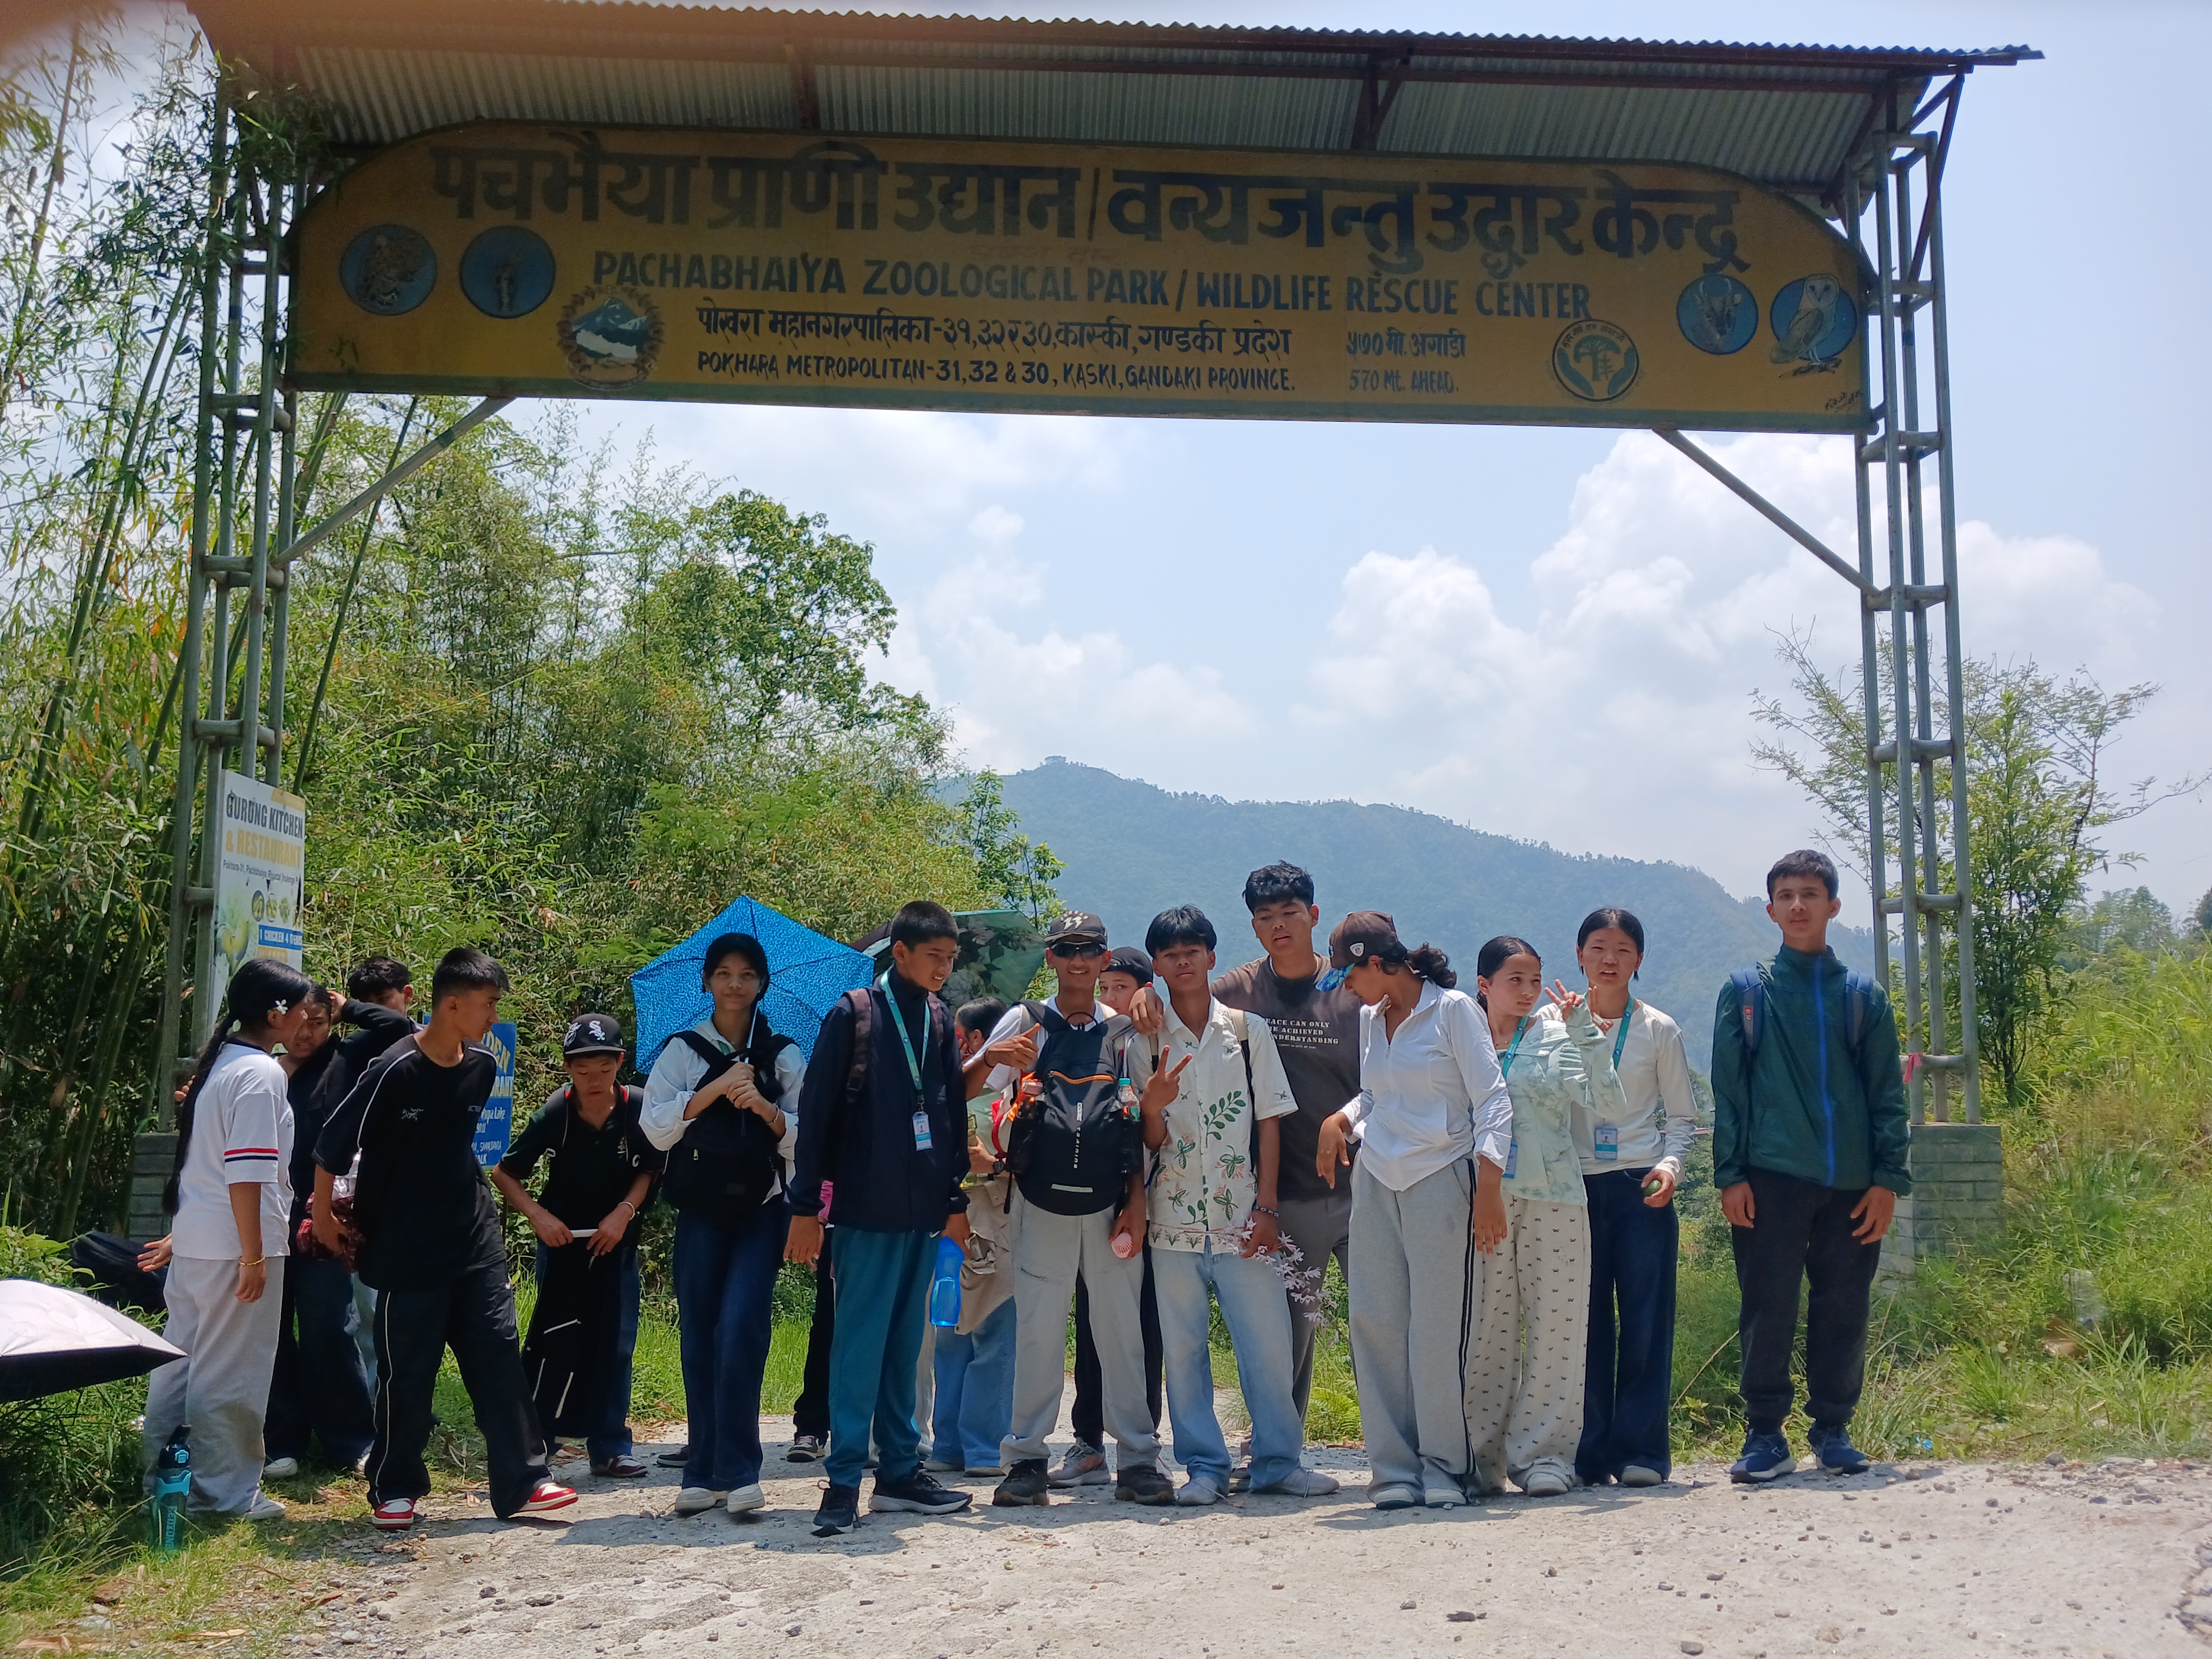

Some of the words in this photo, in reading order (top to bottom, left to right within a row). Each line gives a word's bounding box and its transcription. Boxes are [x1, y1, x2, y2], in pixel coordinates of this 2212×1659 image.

[594, 250, 847, 294] PACHABHAIYA
[863, 259, 1078, 301] ZOOLOGICAL
[1197, 272, 1331, 311] WILDLIFE
[1347, 276, 1458, 314] RESCUE
[1476, 281, 1592, 320] CENTER
[696, 297, 764, 339] पोखरा
[1410, 327, 1467, 358] अगाडी
[698, 351, 779, 376] POKHARA
[1005, 362, 1017, 381] &
[1349, 369, 1379, 391] 570
[269, 808, 303, 840] KITCHEN
[226, 830, 234, 852] &
[237, 828, 302, 869] RESTAURANT
[264, 929, 285, 943] CHICKEN
[494, 1106, 506, 1120] Lake
